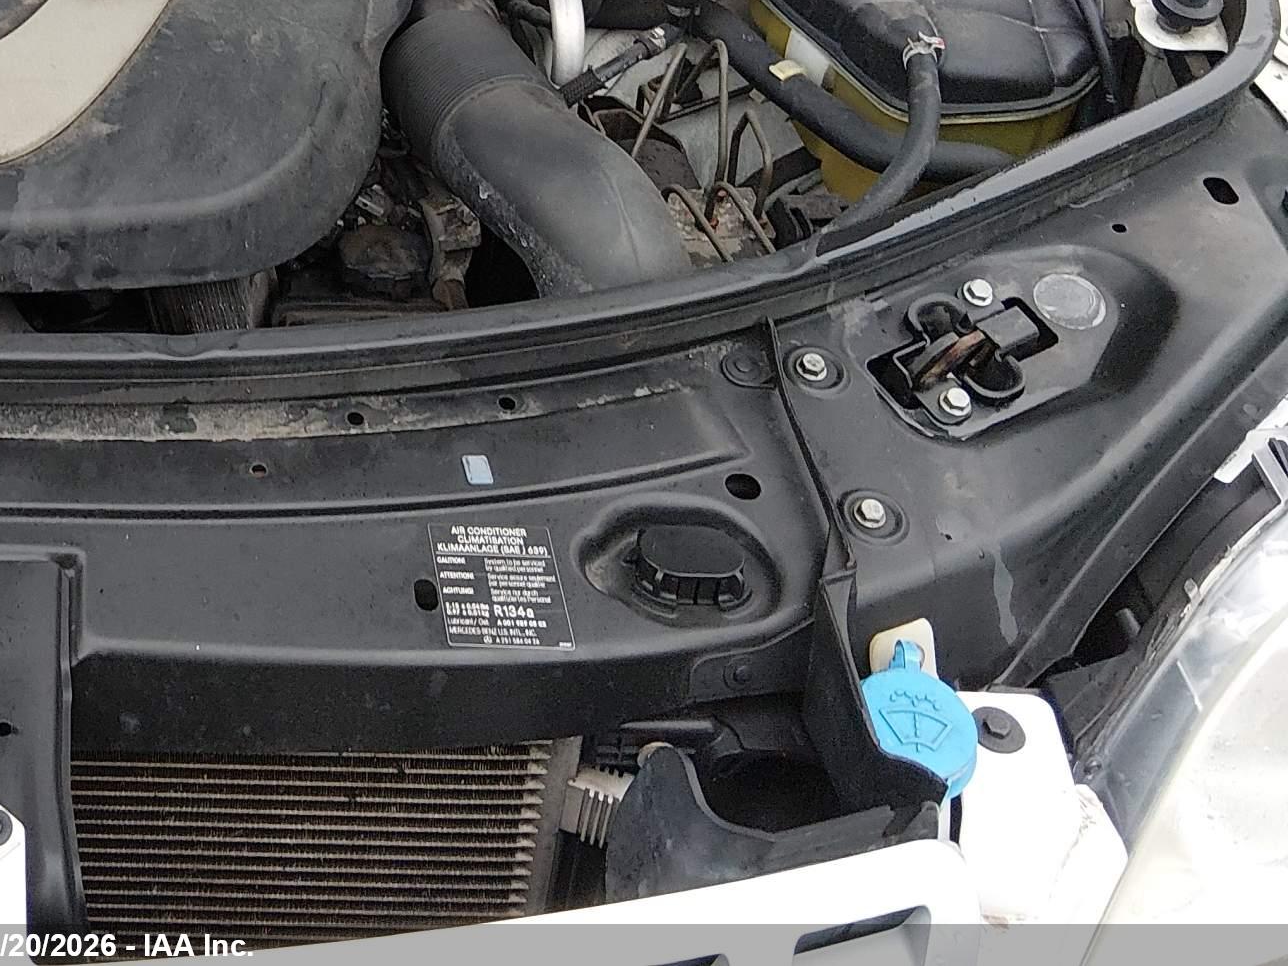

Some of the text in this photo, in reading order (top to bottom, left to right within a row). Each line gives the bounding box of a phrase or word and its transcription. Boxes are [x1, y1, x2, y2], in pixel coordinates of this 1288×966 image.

[451, 526, 527, 537] AIR CONDITIONER
[436, 543, 499, 553] KLIMAANLAGE
[493, 604, 535, 618] R134a
